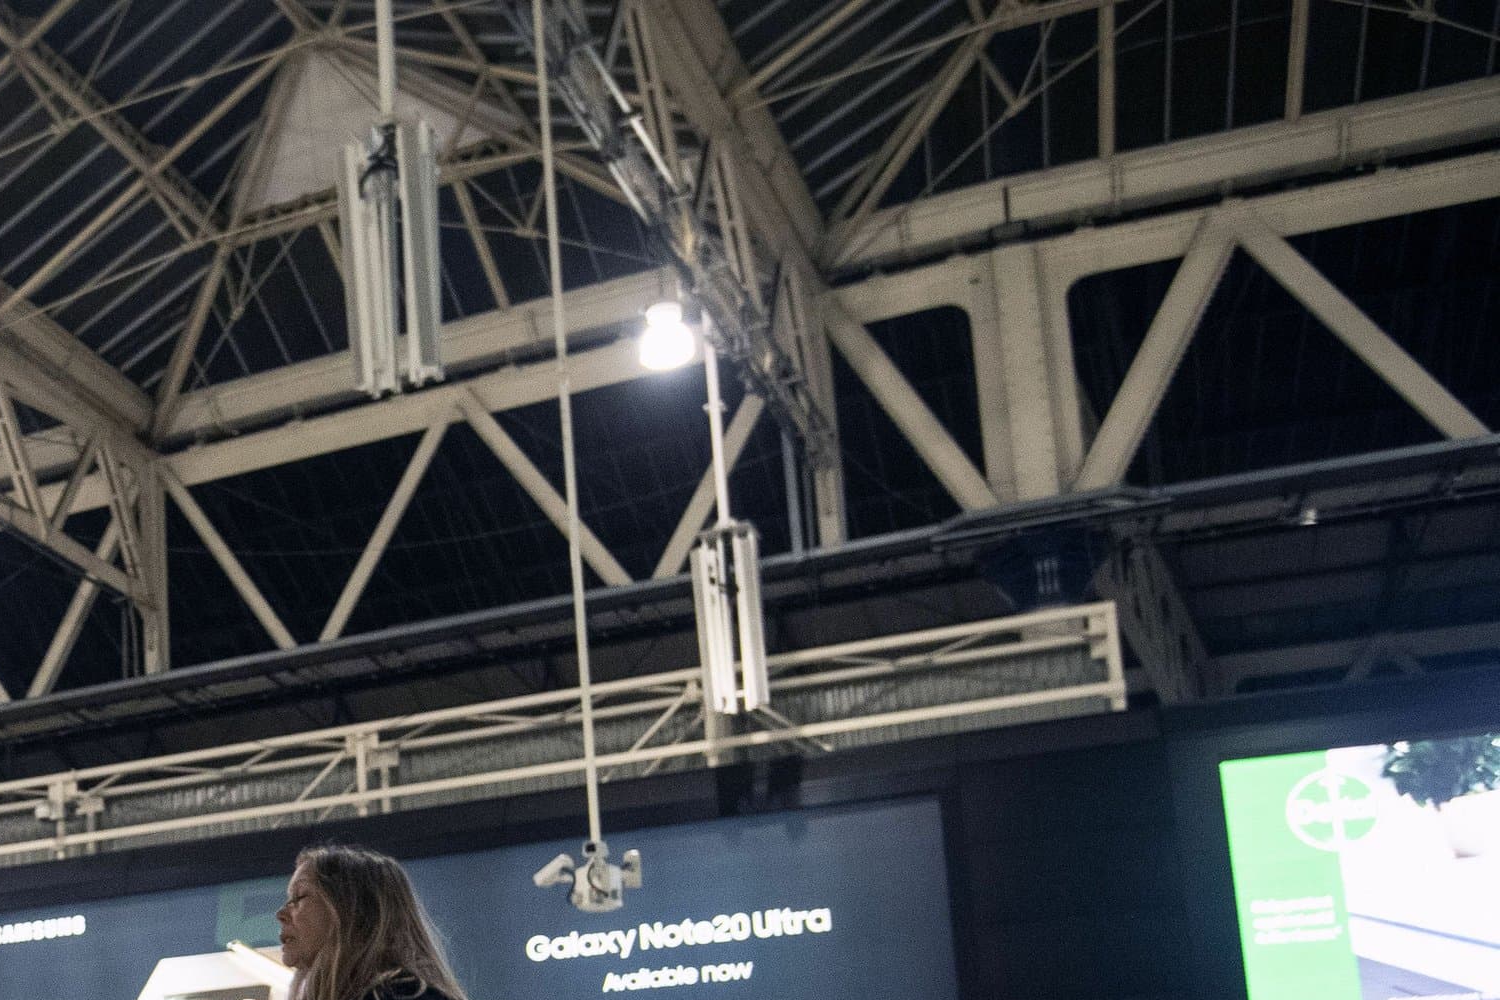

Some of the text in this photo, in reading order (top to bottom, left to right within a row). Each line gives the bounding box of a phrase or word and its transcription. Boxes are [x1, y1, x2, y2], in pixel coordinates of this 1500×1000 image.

[525, 907, 833, 962] Galaxy Note20 Ultra
[602, 961, 754, 993] Available now
